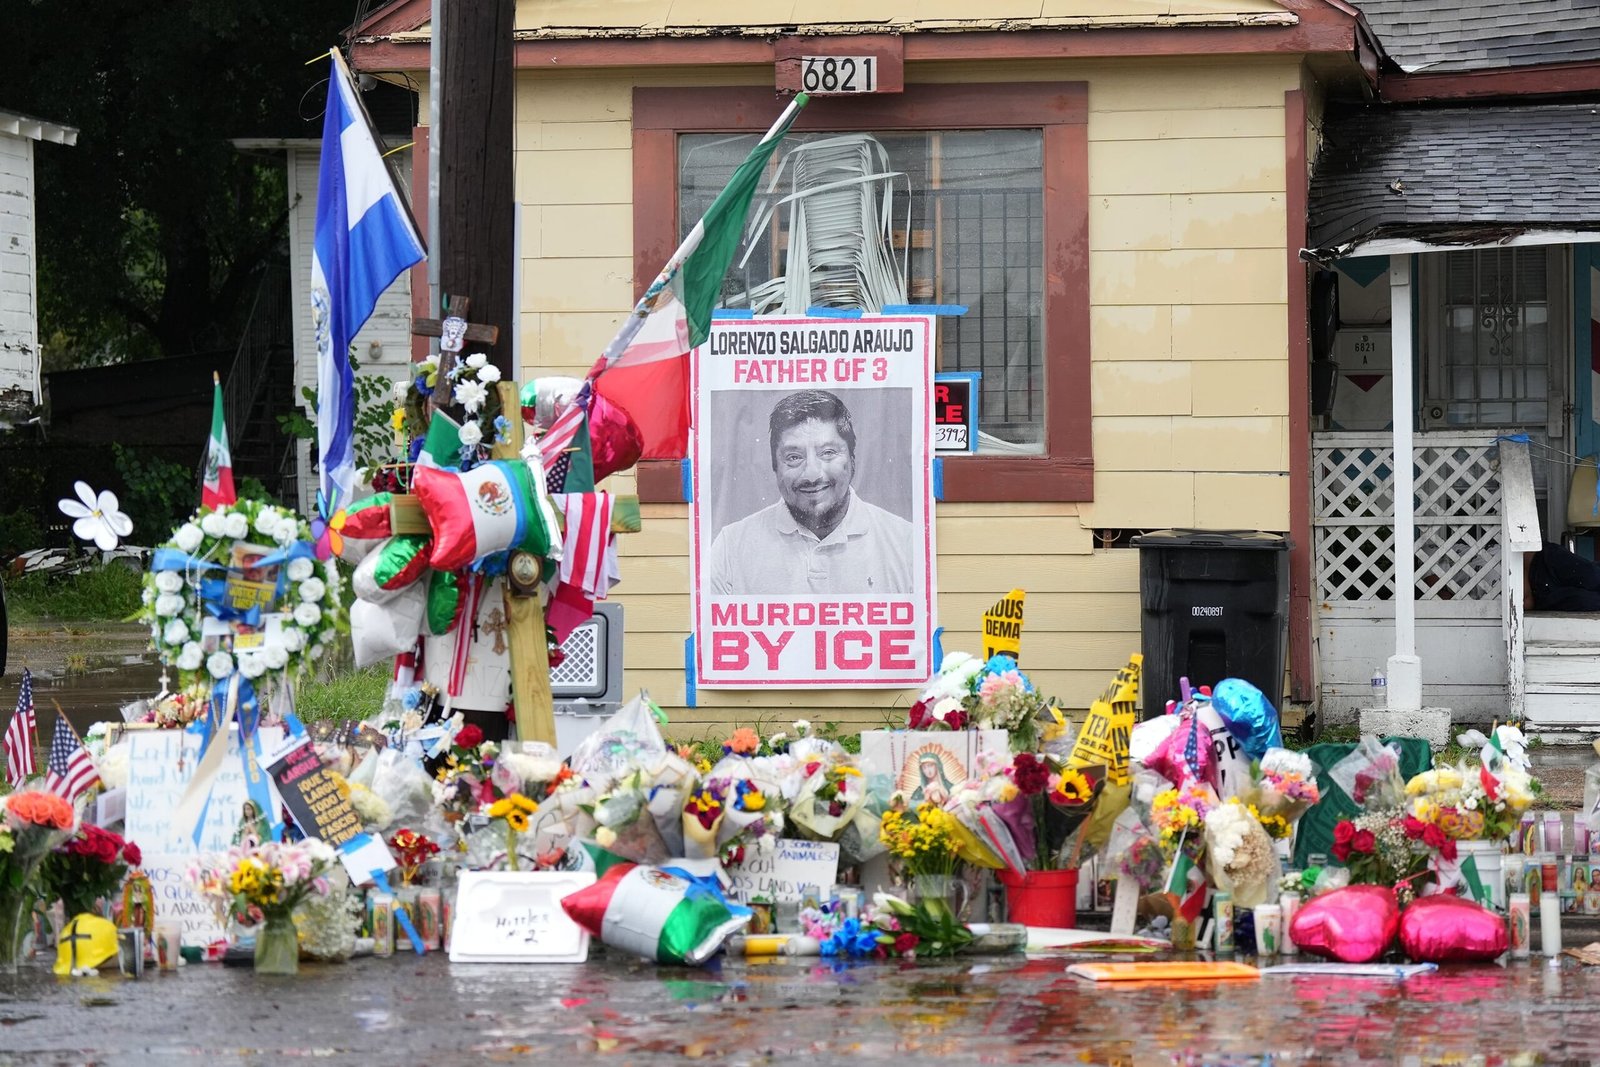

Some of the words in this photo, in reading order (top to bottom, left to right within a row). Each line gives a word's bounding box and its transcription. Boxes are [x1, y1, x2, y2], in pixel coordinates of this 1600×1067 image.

[804, 57, 872, 91] 6821
[710, 331, 776, 355] LORENZO
[780, 329, 849, 353] SALGADO
[852, 329, 913, 352] ARAUJO
[1354, 342, 1375, 352] 6821
[734, 359, 827, 383] FATHER
[834, 358, 866, 382] OF
[872, 357, 888, 381] 3
[711, 602, 914, 626] MURDERED
[1191, 606, 1224, 616] 00240897
[712, 631, 795, 671] BY
[815, 630, 916, 670] ICE
[1086, 714, 1111, 741] TEX
[303, 779, 340, 804] LARGU
